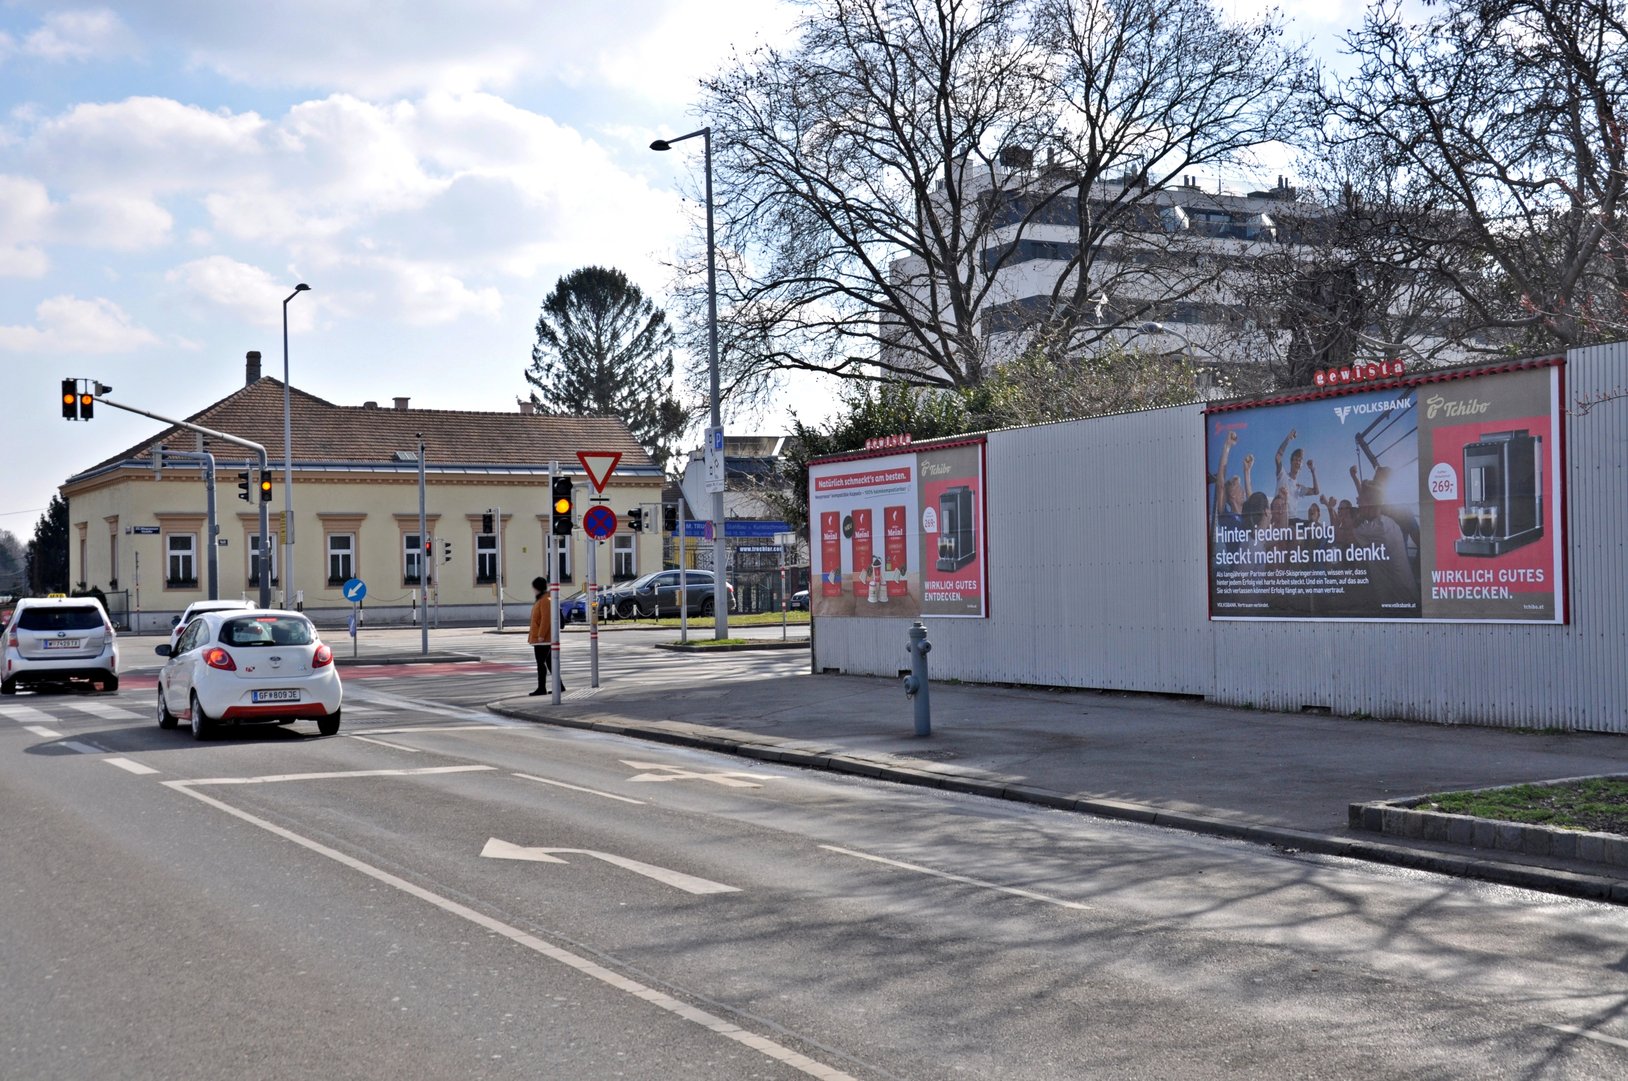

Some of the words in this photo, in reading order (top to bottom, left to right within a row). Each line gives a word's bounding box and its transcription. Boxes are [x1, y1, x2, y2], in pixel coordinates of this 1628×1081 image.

[1316, 362, 1404, 385] gewista
[1352, 398, 1412, 414] VOLKSBANK
[1443, 398, 1492, 417] Tchibo
[716, 432, 721, 448] P
[818, 479, 844, 488] Natürlich
[844, 476, 874, 486] schmeckt's
[1215, 526, 1252, 542] Hinter
[1254, 524, 1293, 546] jedem
[1295, 522, 1335, 544] Erfolg
[1215, 548, 1251, 565] steckt
[1254, 546, 1288, 563] mehr
[1290, 545, 1309, 563] als
[1313, 548, 1342, 562] man
[1346, 542, 1390, 561] denkt.
[1431, 569, 1493, 583] WIRKLICH
[1498, 569, 1544, 582] GUTES
[955, 580, 977, 589] GUTES
[1271, 587, 1285, 595] Erfolg
[924, 592, 963, 601] ENTDECKEN.
[1432, 586, 1513, 599] ENTDECKEN.
